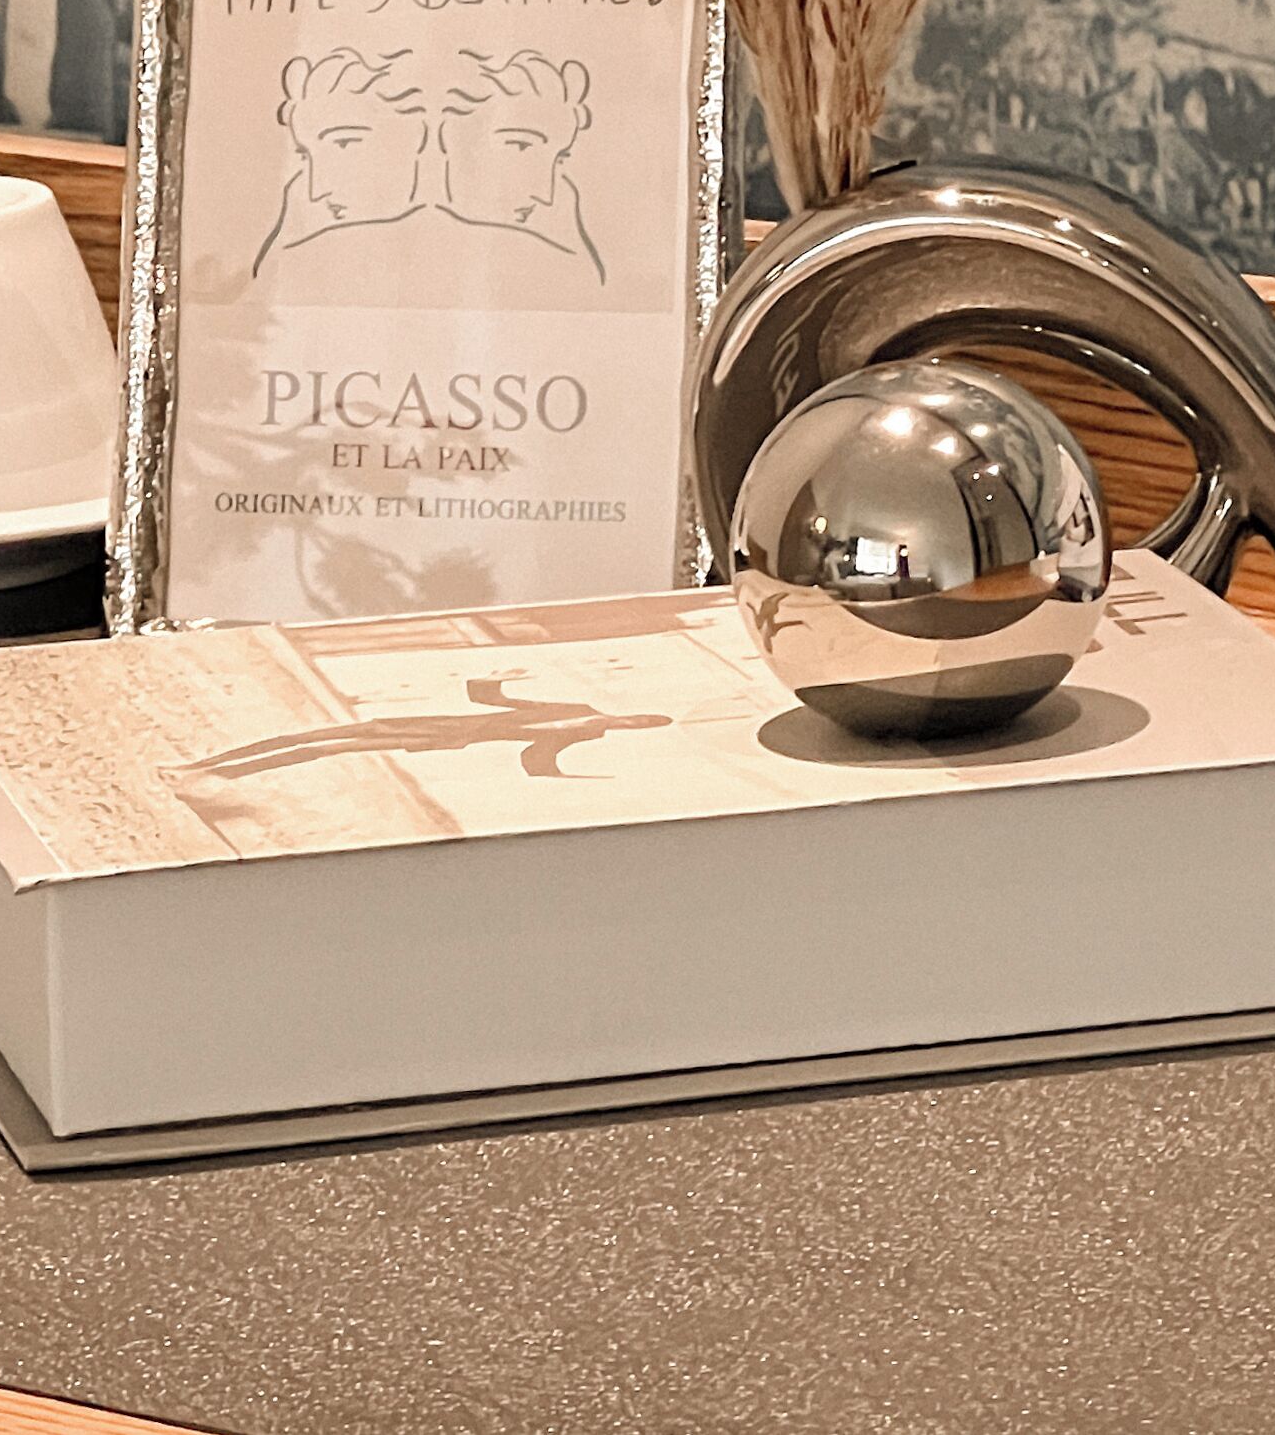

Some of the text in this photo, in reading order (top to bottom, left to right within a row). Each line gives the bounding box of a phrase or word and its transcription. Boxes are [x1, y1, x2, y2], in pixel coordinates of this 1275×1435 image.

[259, 368, 589, 434] PICASSO
[331, 442, 512, 473] ET LA PAIX
[213, 491, 628, 524] ORIGINAUX ET LITHOGRAPHIES
